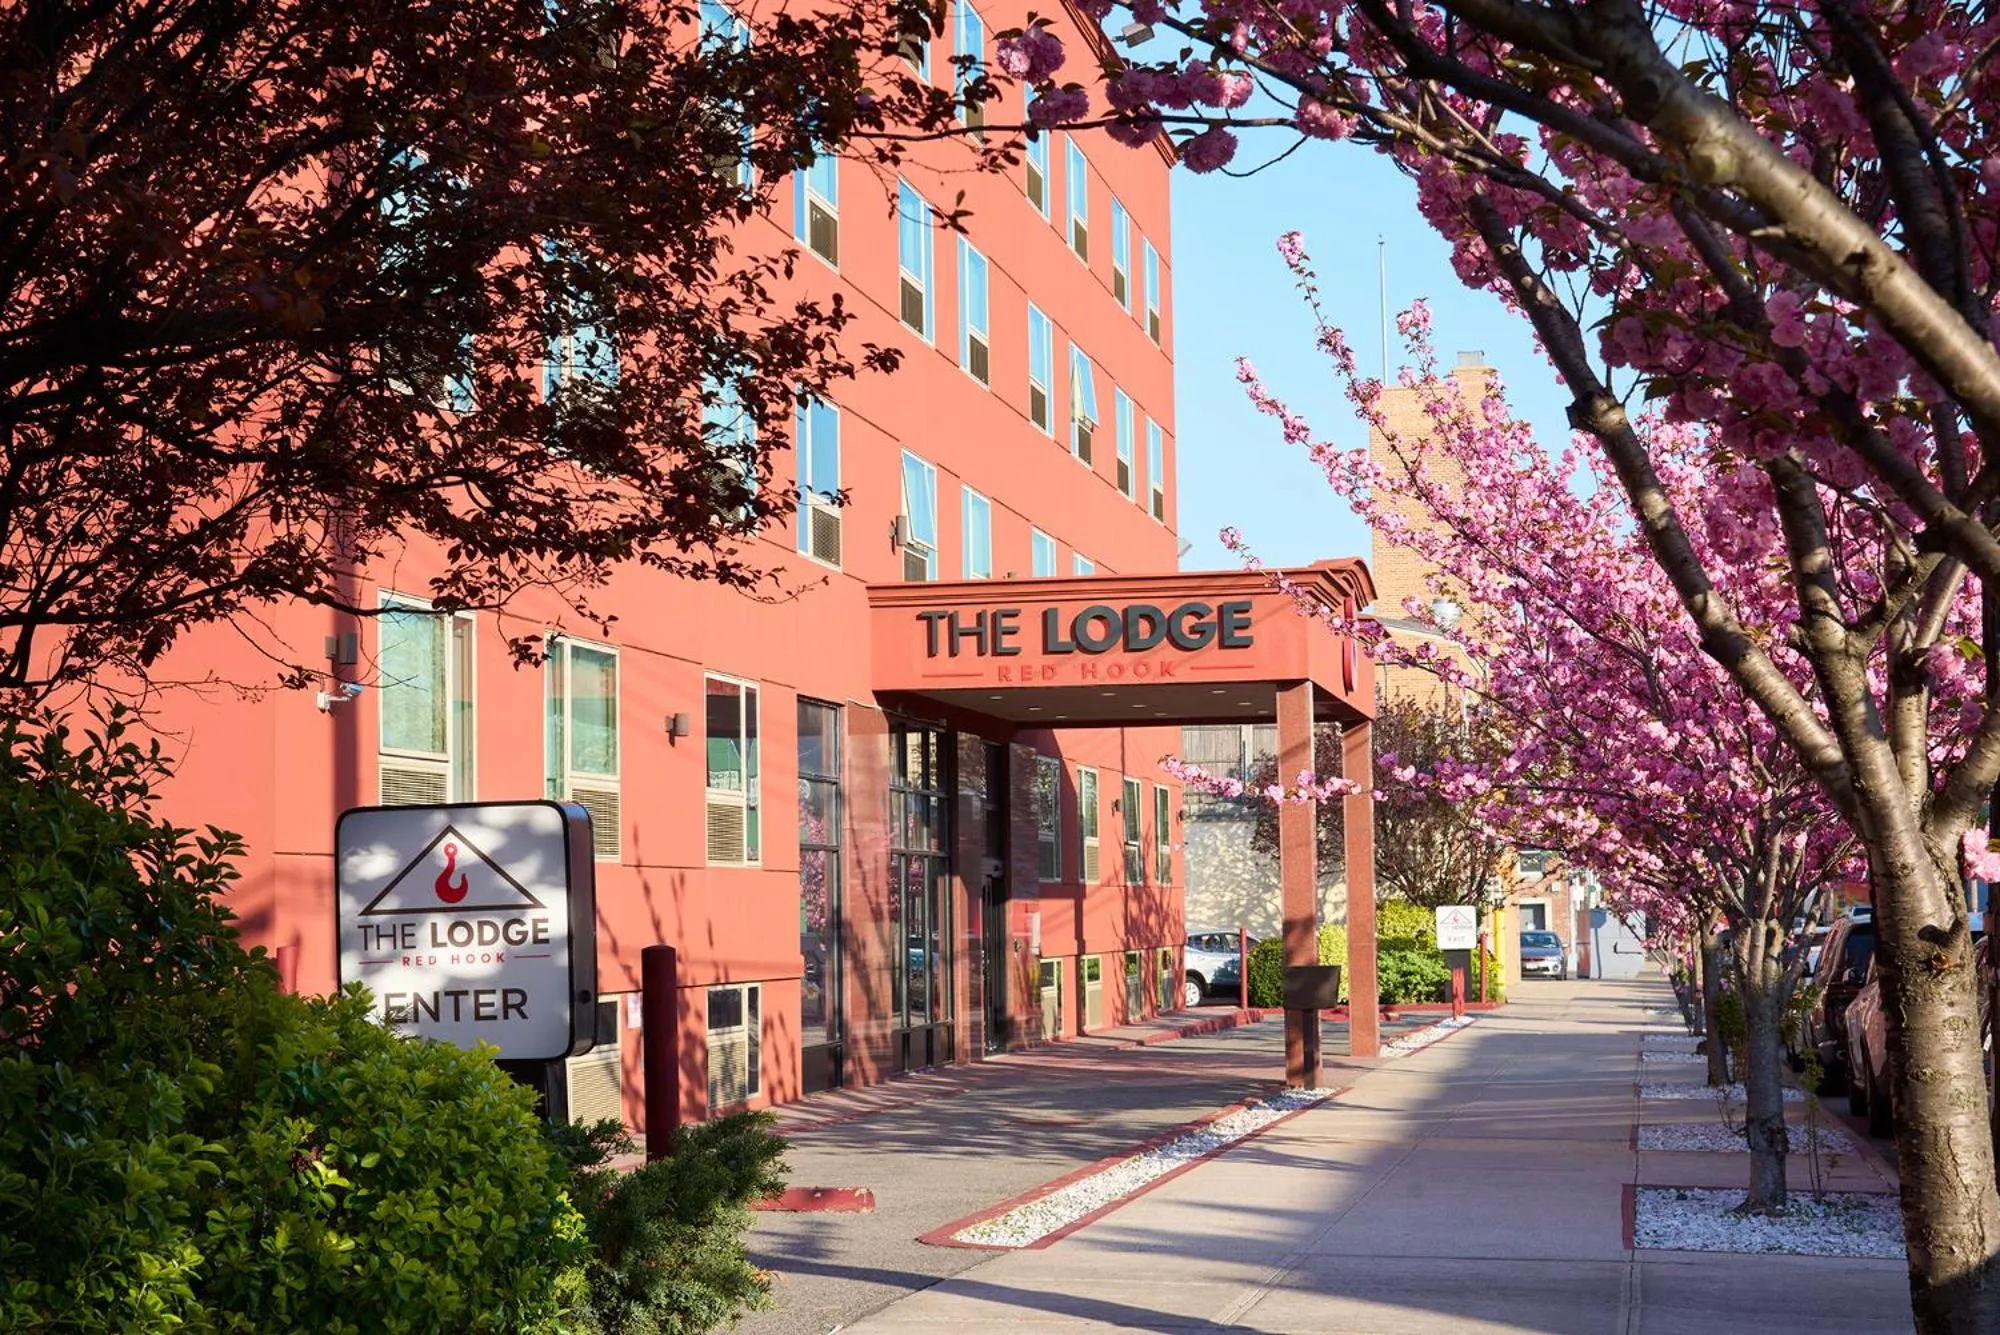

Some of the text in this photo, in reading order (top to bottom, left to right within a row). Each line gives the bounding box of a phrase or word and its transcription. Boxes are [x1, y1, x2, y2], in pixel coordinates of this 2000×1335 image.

[917, 601, 1254, 657] THE LODGE
[998, 660, 1177, 683] RED HOOK
[357, 918, 550, 951] THE LODGE
[402, 952, 506, 966] RED HOOK
[383, 988, 529, 1024] ENTER
